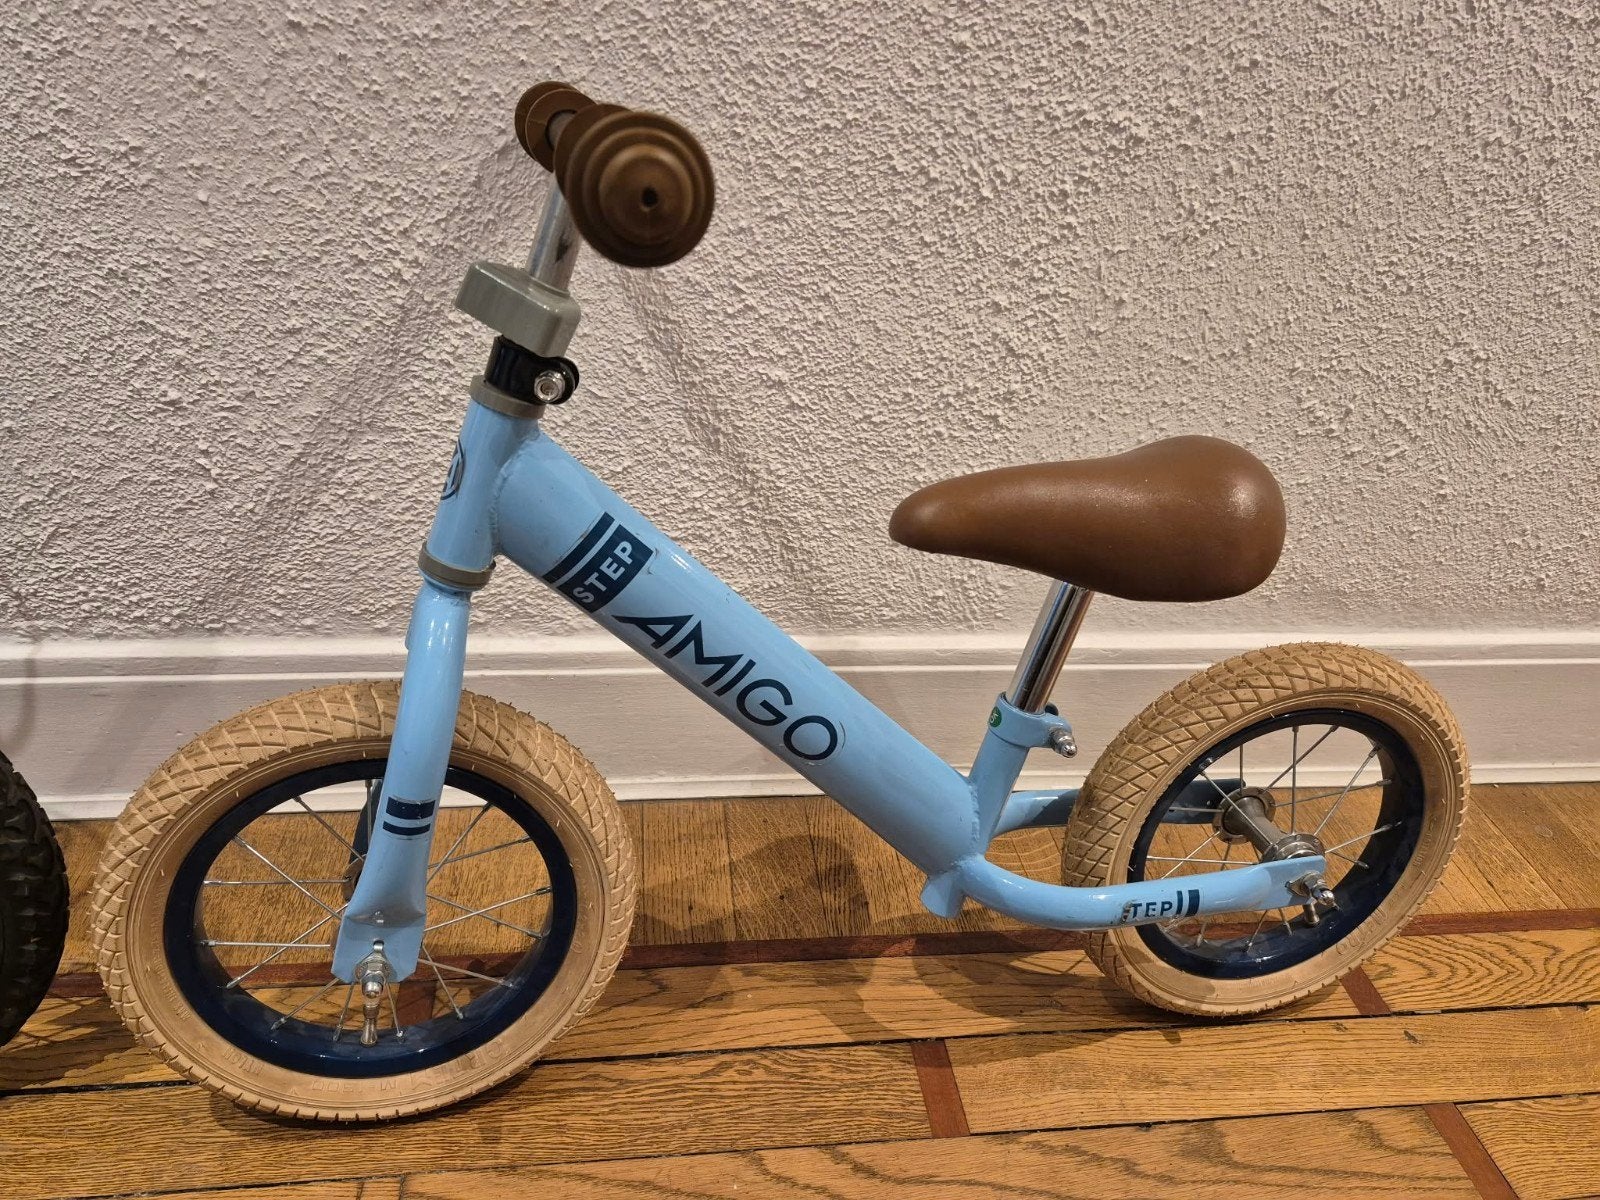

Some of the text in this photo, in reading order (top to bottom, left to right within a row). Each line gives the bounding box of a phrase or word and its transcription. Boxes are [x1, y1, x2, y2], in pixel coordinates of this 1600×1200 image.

[572, 540, 634, 604] STEP
[611, 614, 838, 761] AMIGO
[1120, 900, 1174, 921] TEP
